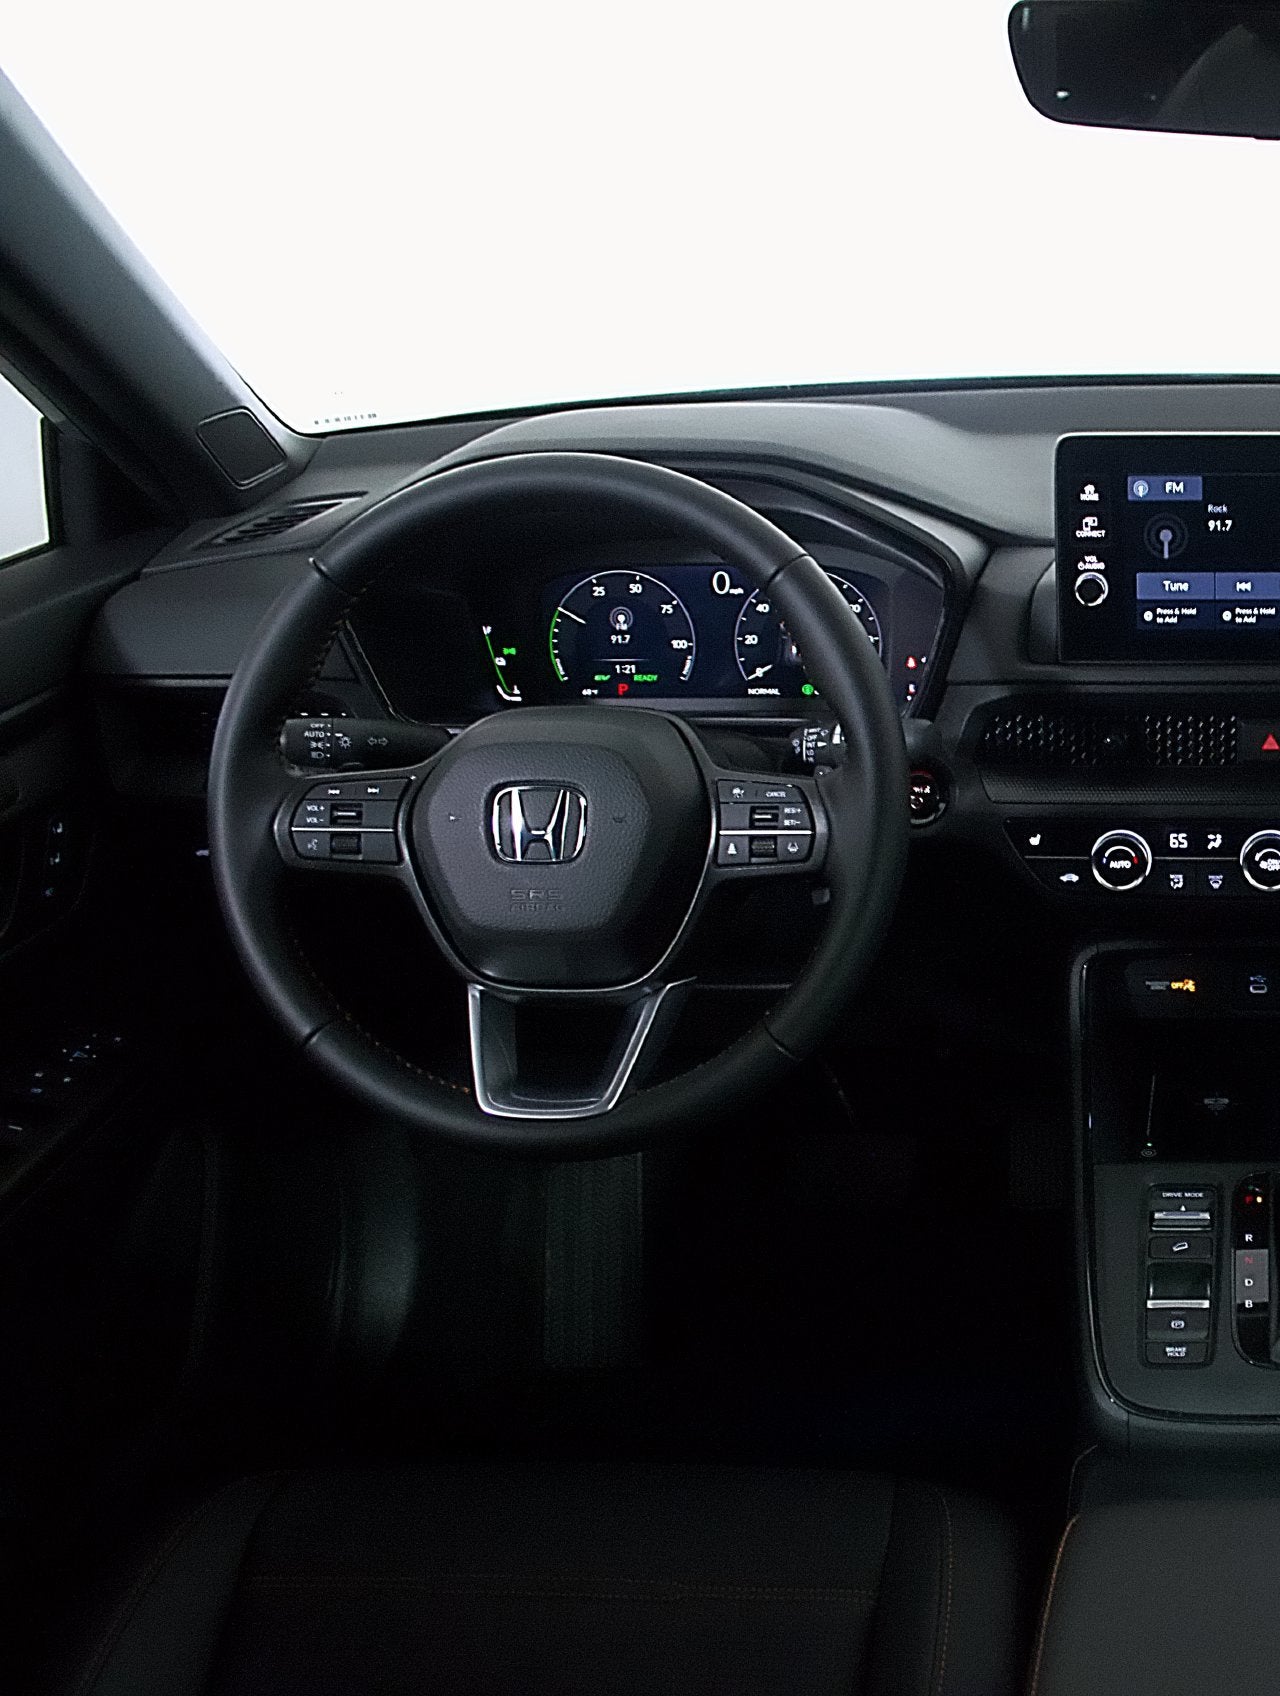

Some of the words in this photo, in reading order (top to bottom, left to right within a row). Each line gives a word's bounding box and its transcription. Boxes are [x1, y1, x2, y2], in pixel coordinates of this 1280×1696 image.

[1165, 482, 1184, 493] FM
[1208, 504, 1228, 513] Rock
[1208, 520, 1232, 531] 91.7
[1075, 530, 1106, 538] CONNECT
[713, 571, 730, 595] 0
[1163, 580, 1189, 592] Tune
[592, 587, 605, 596] 25
[629, 584, 642, 594] 50
[661, 605, 673, 614] 75
[756, 604, 769, 613] 40
[1156, 607, 1173, 615] Press
[1181, 607, 1196, 615] Hold
[1235, 607, 1252, 615] Press
[1260, 607, 1275, 615] Hold
[610, 635, 630, 644] 91.7
[671, 639, 687, 649] 100
[744, 635, 758, 645] 20
[615, 665, 636, 674] 1:21
[618, 684, 629, 695] P
[1169, 833, 1188, 848] 65
[1109, 860, 1132, 869] AUTO
[510, 889, 560, 899] SRS
[1245, 1233, 1253, 1242] R
[1245, 1278, 1254, 1287] D
[1245, 1299, 1253, 1308] B
